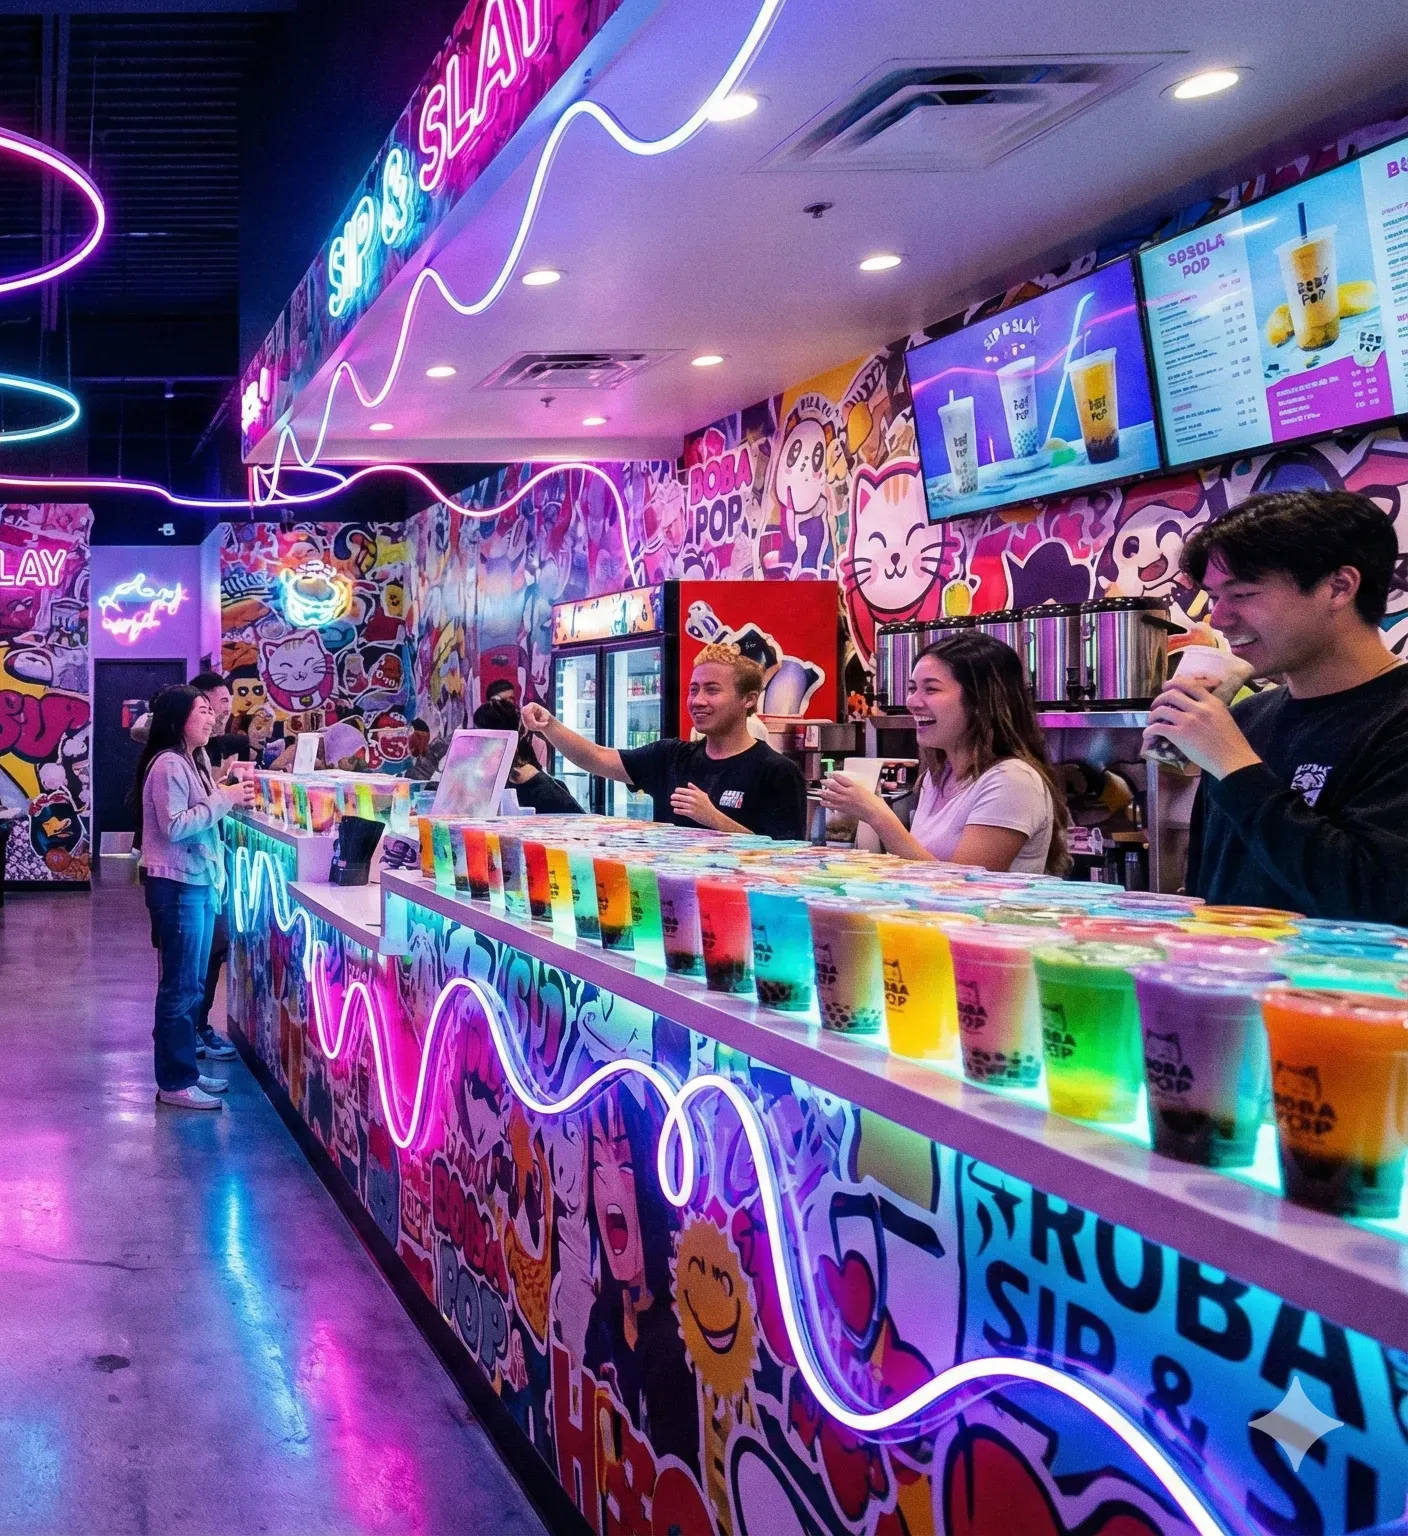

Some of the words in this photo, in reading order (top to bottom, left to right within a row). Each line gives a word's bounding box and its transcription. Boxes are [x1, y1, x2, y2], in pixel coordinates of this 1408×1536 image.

[329, 196, 374, 317] SIP
[690, 448, 752, 506] BOBA
[695, 495, 743, 546] POP
[884, 992, 907, 1007] OP
[432, 1157, 510, 1303] BOBA
[440, 1240, 509, 1368] POP
